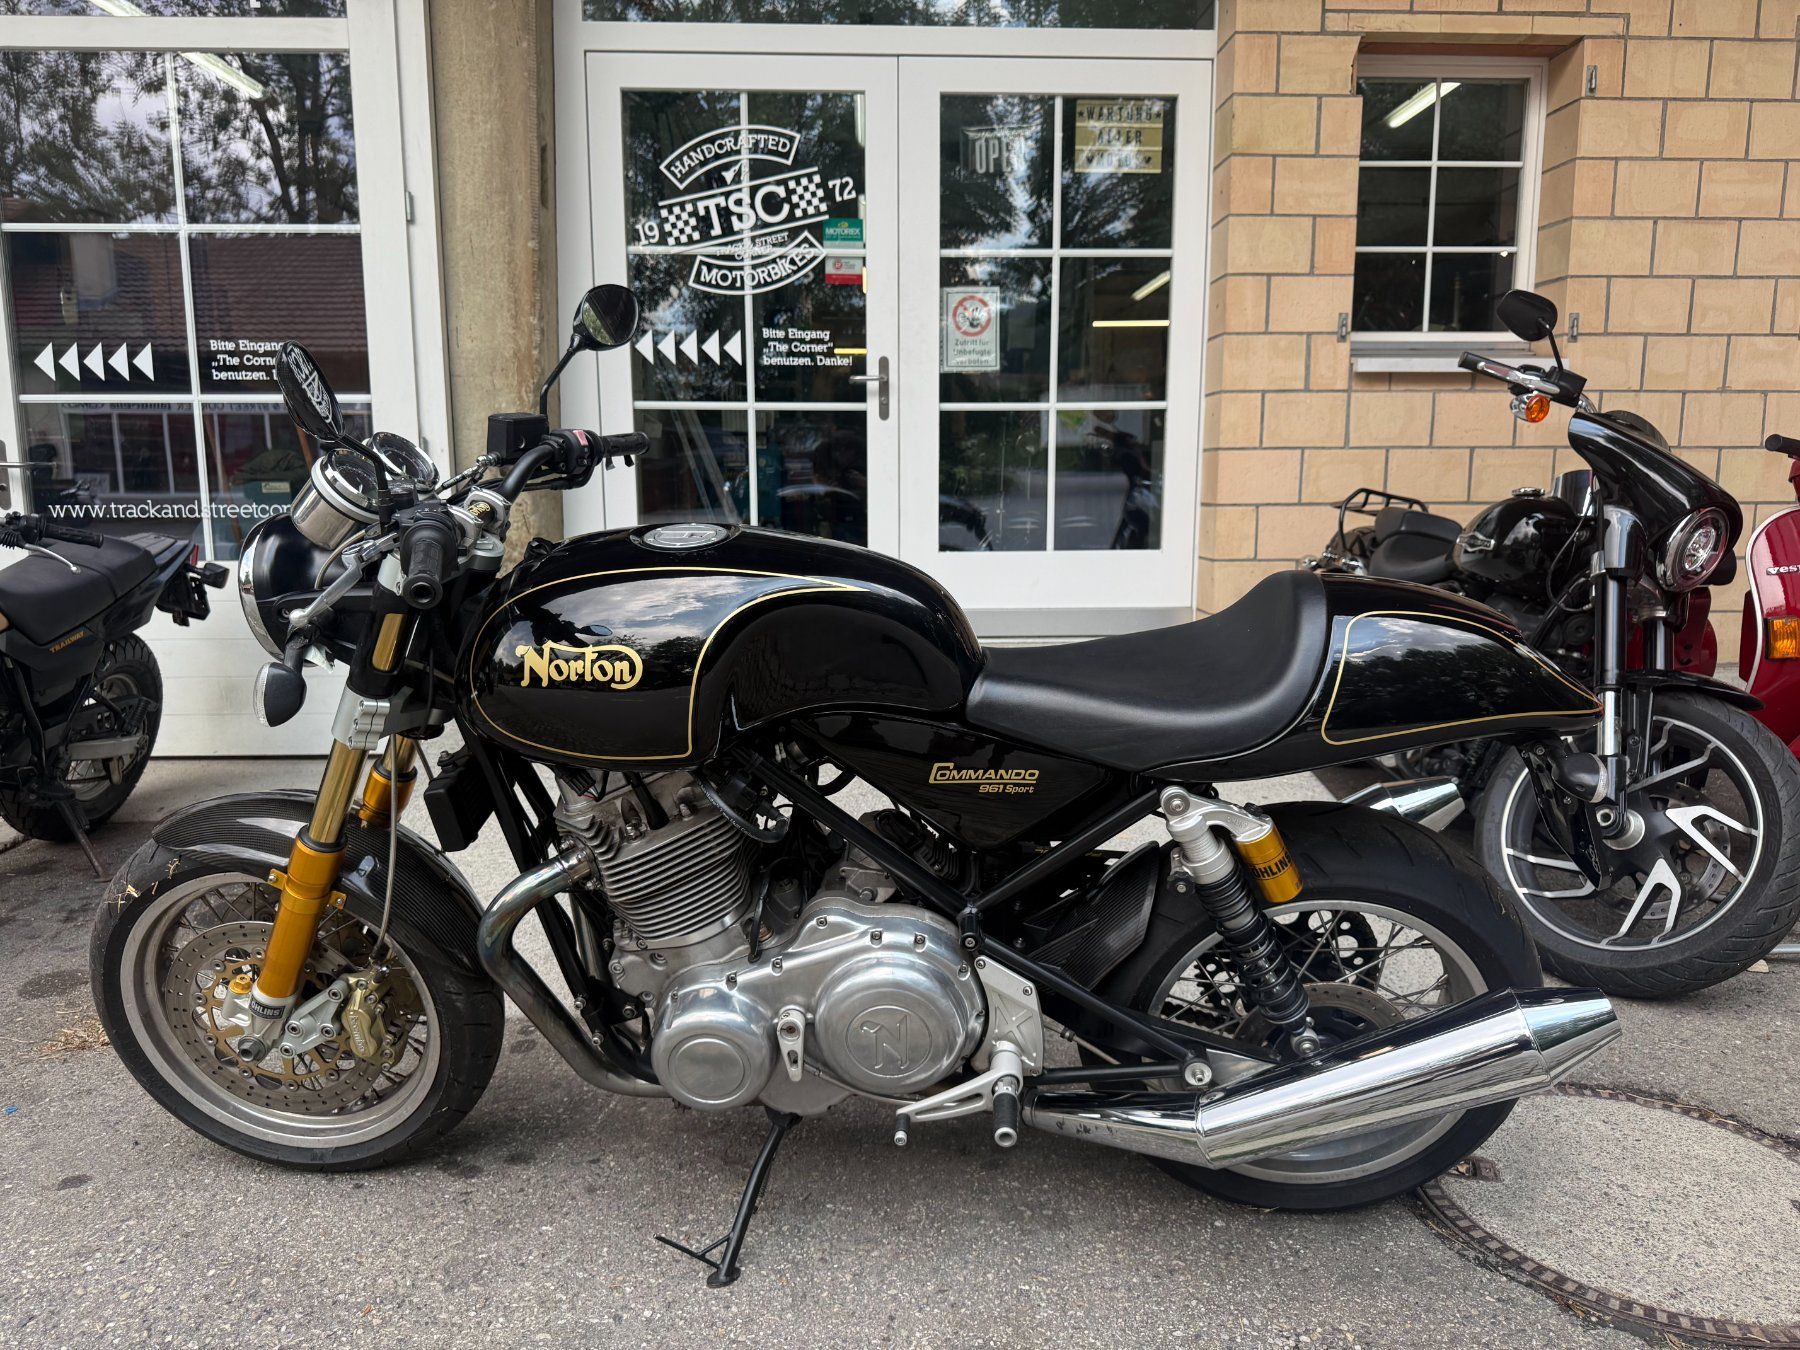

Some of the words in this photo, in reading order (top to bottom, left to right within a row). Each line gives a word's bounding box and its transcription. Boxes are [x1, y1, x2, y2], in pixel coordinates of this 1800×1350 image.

[670, 134, 790, 178] HANDCRAFTED
[635, 221, 659, 247] 19
[697, 185, 790, 237] TSC
[828, 176, 856, 202] 72
[825, 227, 861, 236] MOTOREX
[755, 232, 789, 248] STREET
[700, 243, 815, 287] MOTORBIKES
[762, 327, 785, 339] Bitte
[788, 328, 830, 341] Eingang
[209, 340, 236, 351] Bitte
[954, 338, 977, 346] Zutritt
[763, 355, 814, 366] benutzen.
[816, 355, 853, 366] Danke!
[212, 369, 270, 380] benutzen.
[515, 640, 643, 690] Norton
[929, 763, 1039, 784] COMMANDO
[979, 784, 1004, 793] 961
[1005, 784, 1035, 794] Sport
